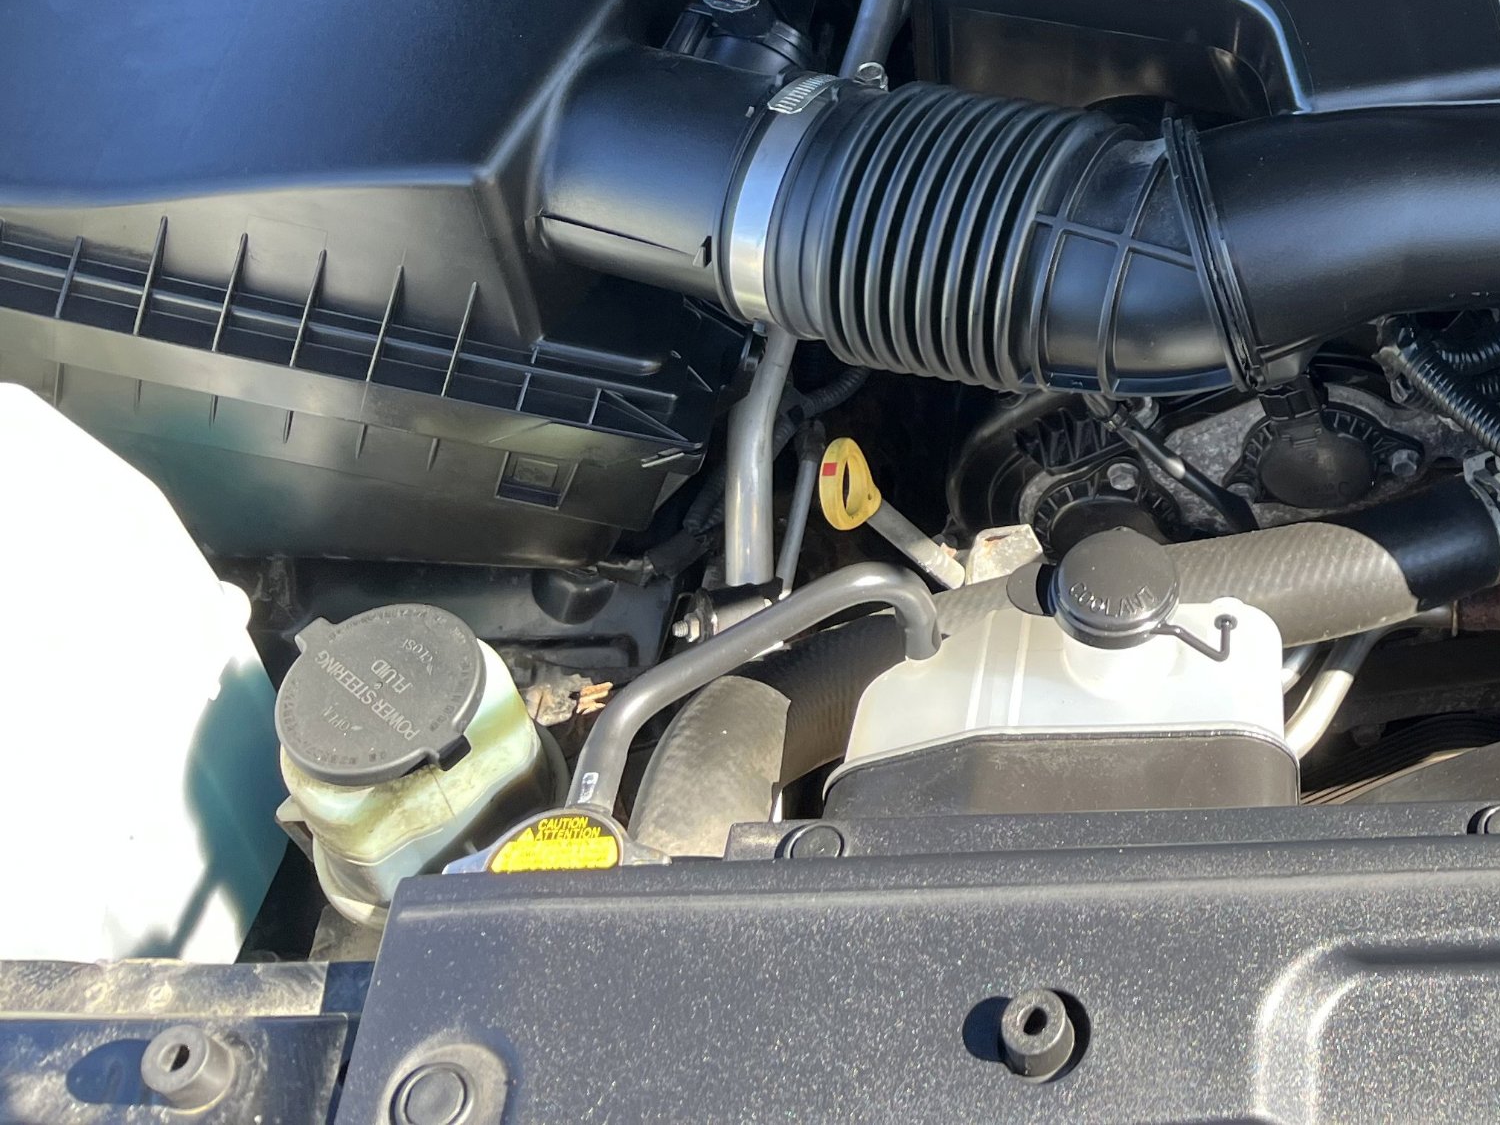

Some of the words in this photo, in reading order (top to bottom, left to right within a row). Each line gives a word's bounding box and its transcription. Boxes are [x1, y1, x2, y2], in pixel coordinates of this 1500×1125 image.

[1070, 581, 1156, 618] COOLANT
[314, 649, 378, 705] STEERING
[370, 658, 413, 695] FLUID
[371, 697, 420, 741] POWER
[534, 826, 601, 842] ATTENTION
[537, 816, 589, 830] CAUTION
